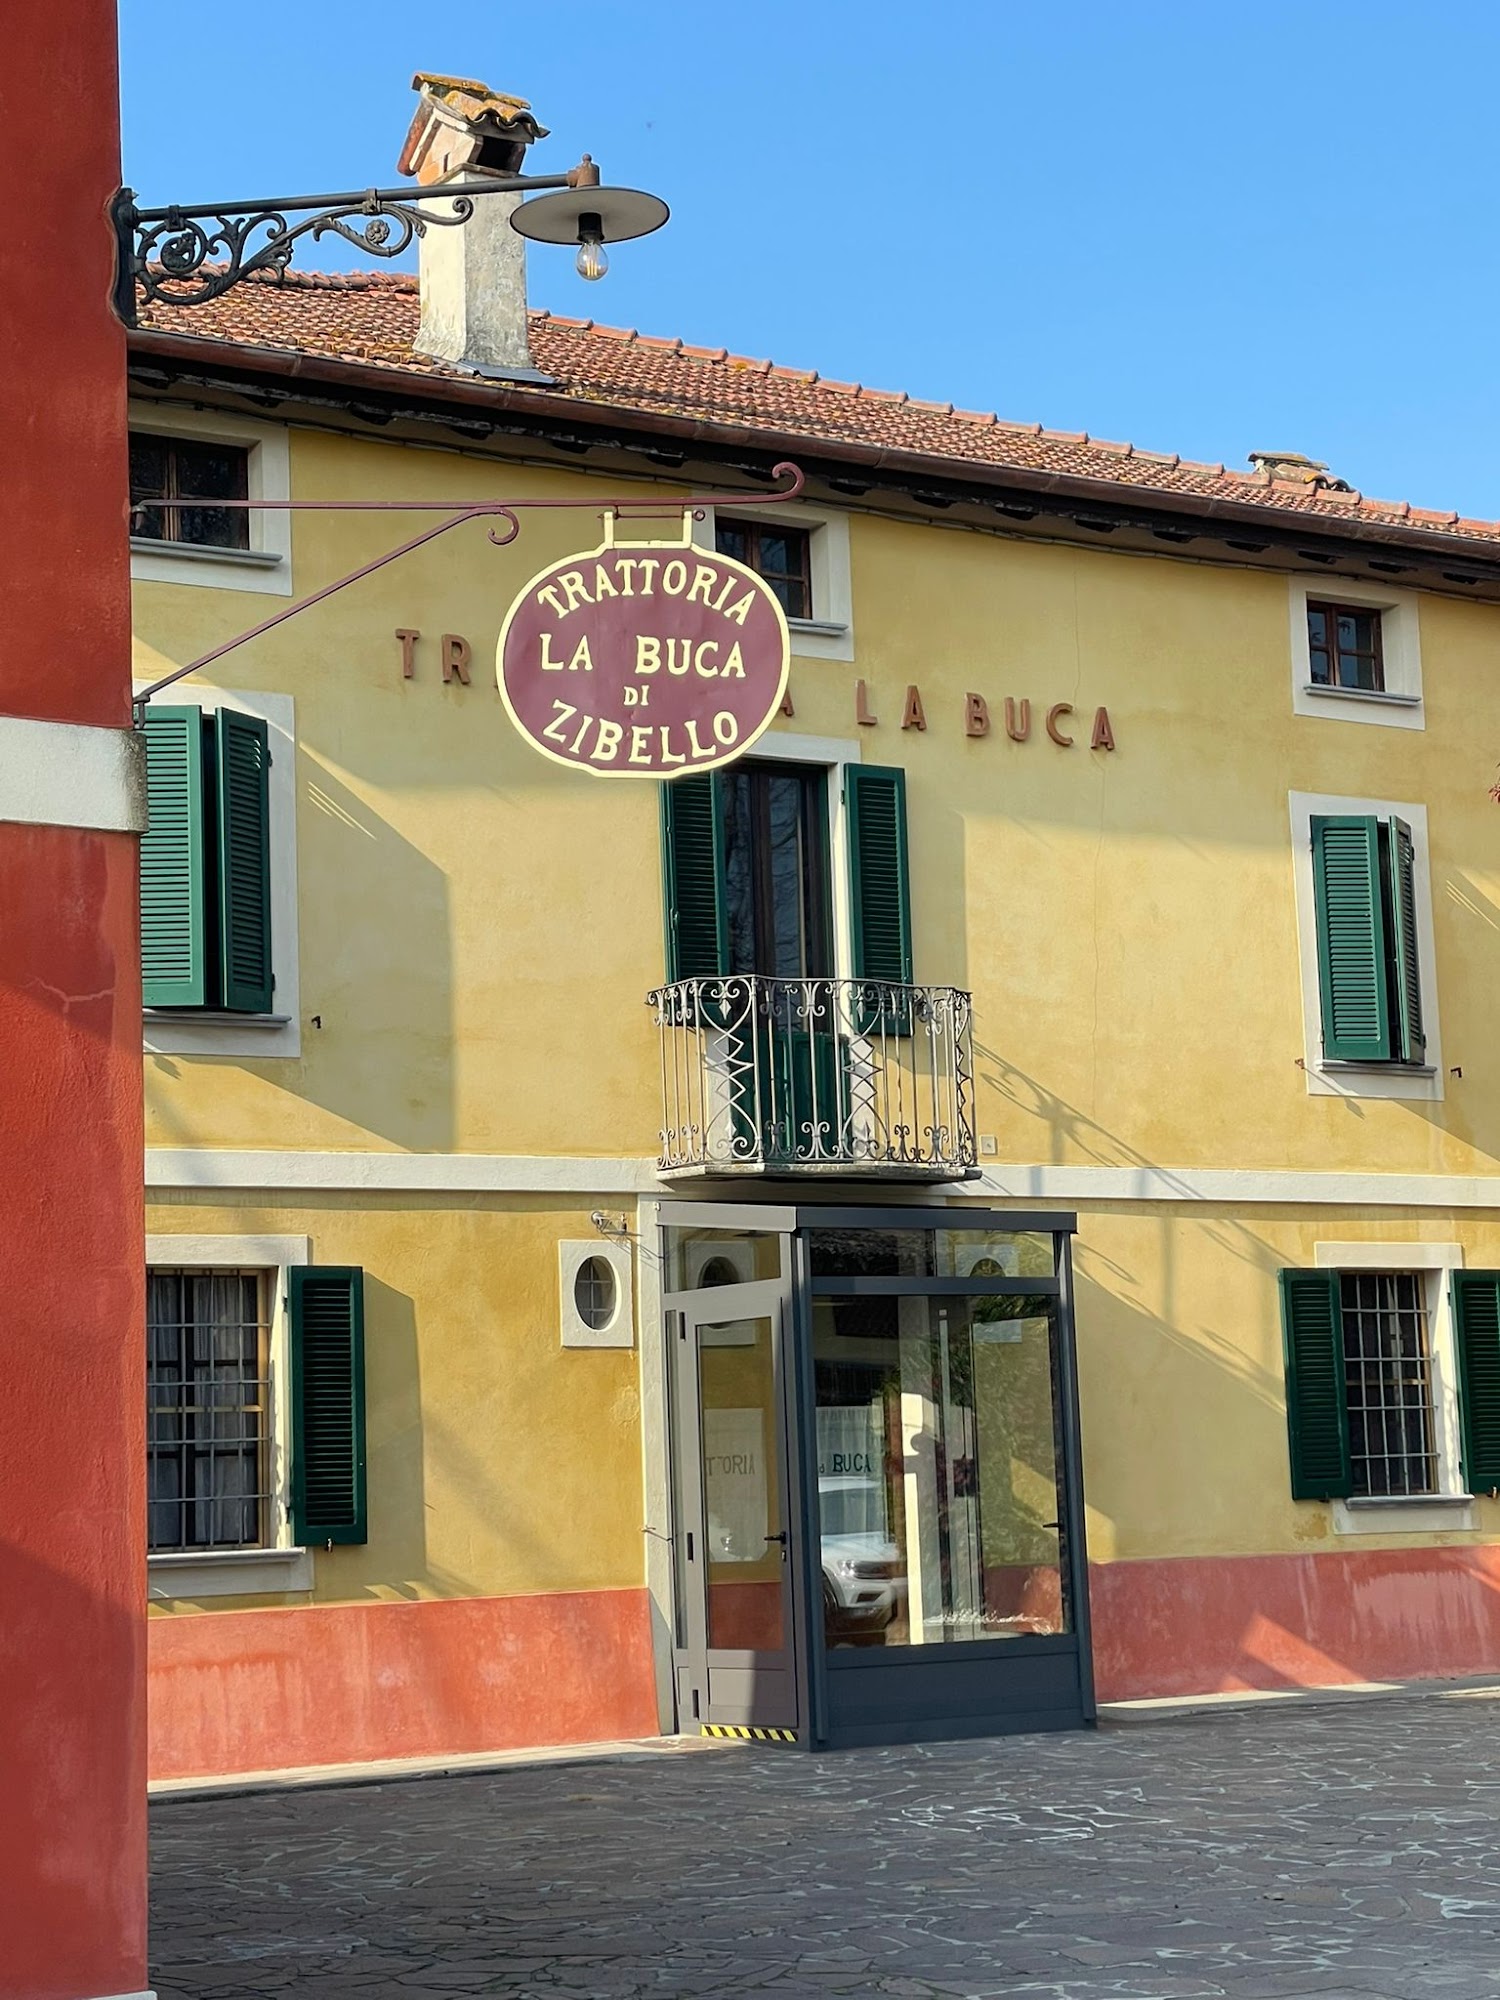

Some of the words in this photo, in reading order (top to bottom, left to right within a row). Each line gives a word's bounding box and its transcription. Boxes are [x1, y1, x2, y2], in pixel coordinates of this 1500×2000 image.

[538, 560, 756, 625] TRATTORIA
[540, 633, 593, 671] LA
[635, 635, 747, 678] BUCA
[623, 684, 650, 706] DI
[855, 679, 928, 731] LA
[965, 692, 1115, 751] BUCA
[542, 699, 739, 765] ZIBELLO
[832, 1453, 872, 1473] BUCA
